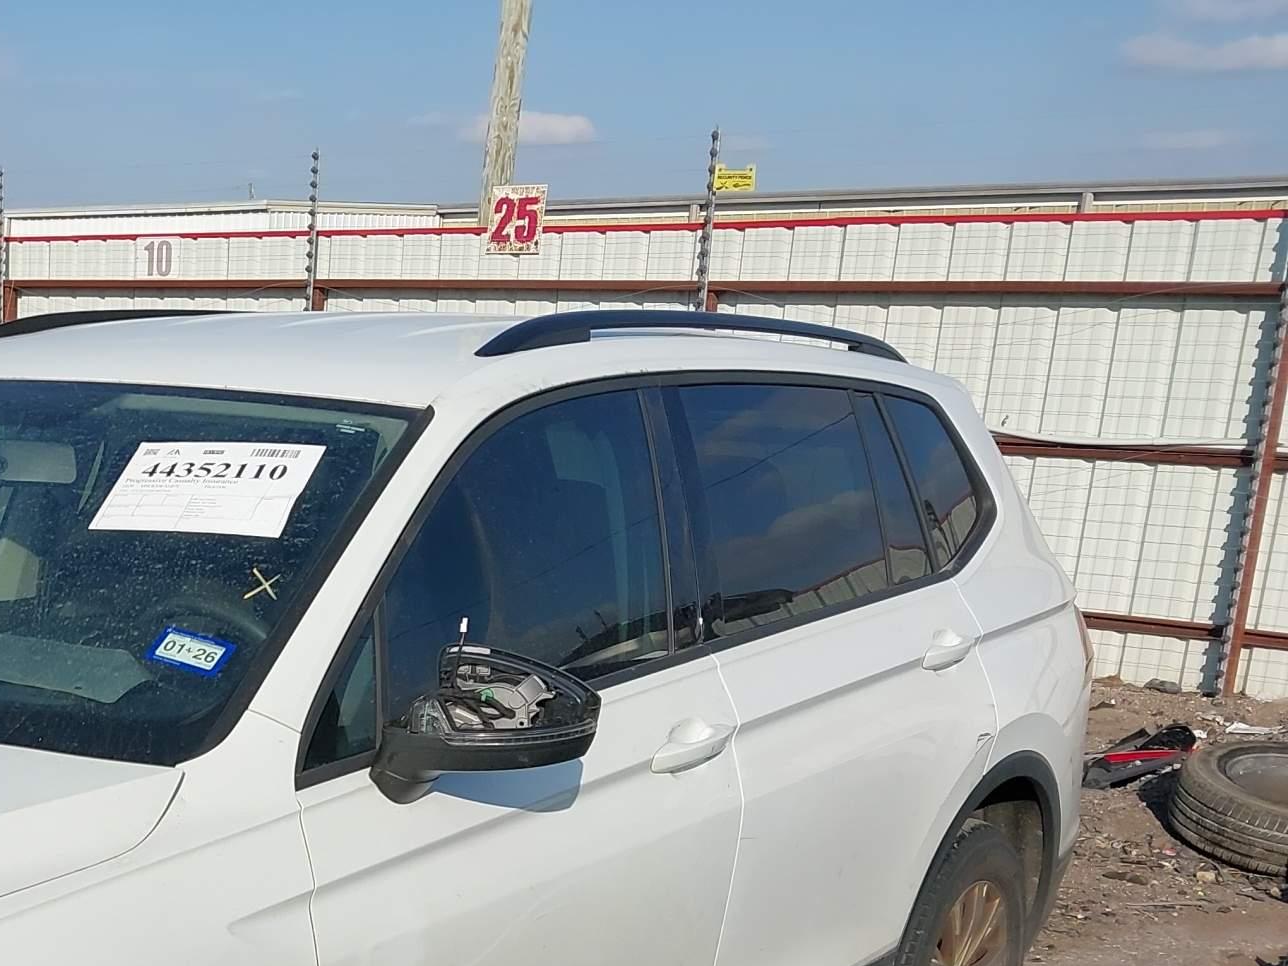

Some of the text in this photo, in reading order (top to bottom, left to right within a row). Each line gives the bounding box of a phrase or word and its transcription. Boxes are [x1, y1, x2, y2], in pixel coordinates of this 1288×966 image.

[492, 196, 540, 243] 25
[144, 240, 172, 277] 10
[142, 462, 288, 481] 44352110
